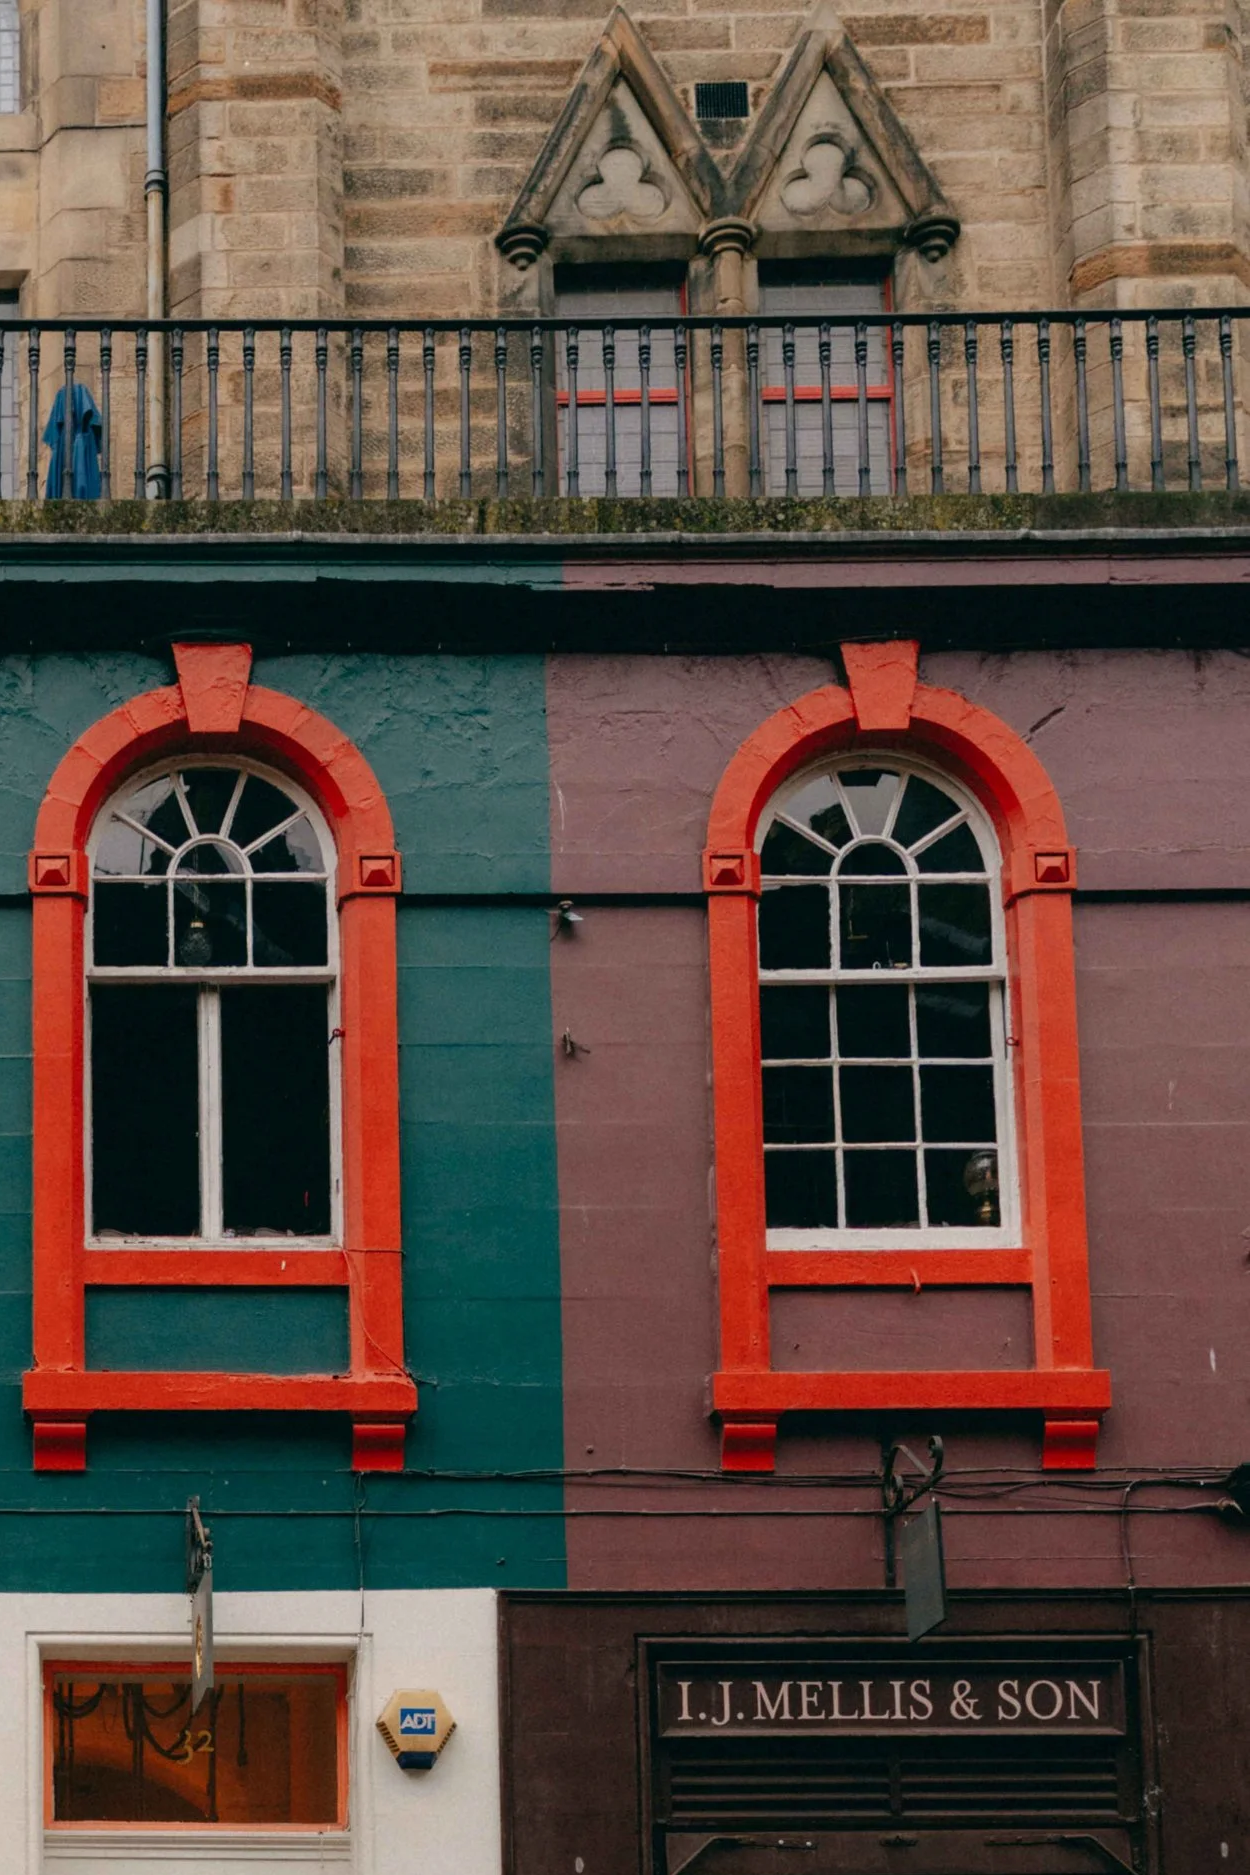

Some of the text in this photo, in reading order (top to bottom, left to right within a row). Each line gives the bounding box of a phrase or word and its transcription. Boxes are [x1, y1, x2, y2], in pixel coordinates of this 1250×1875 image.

[950, 1680, 983, 1720] &
[998, 1680, 1100, 1720] SON
[401, 1713, 436, 1729] ADT
